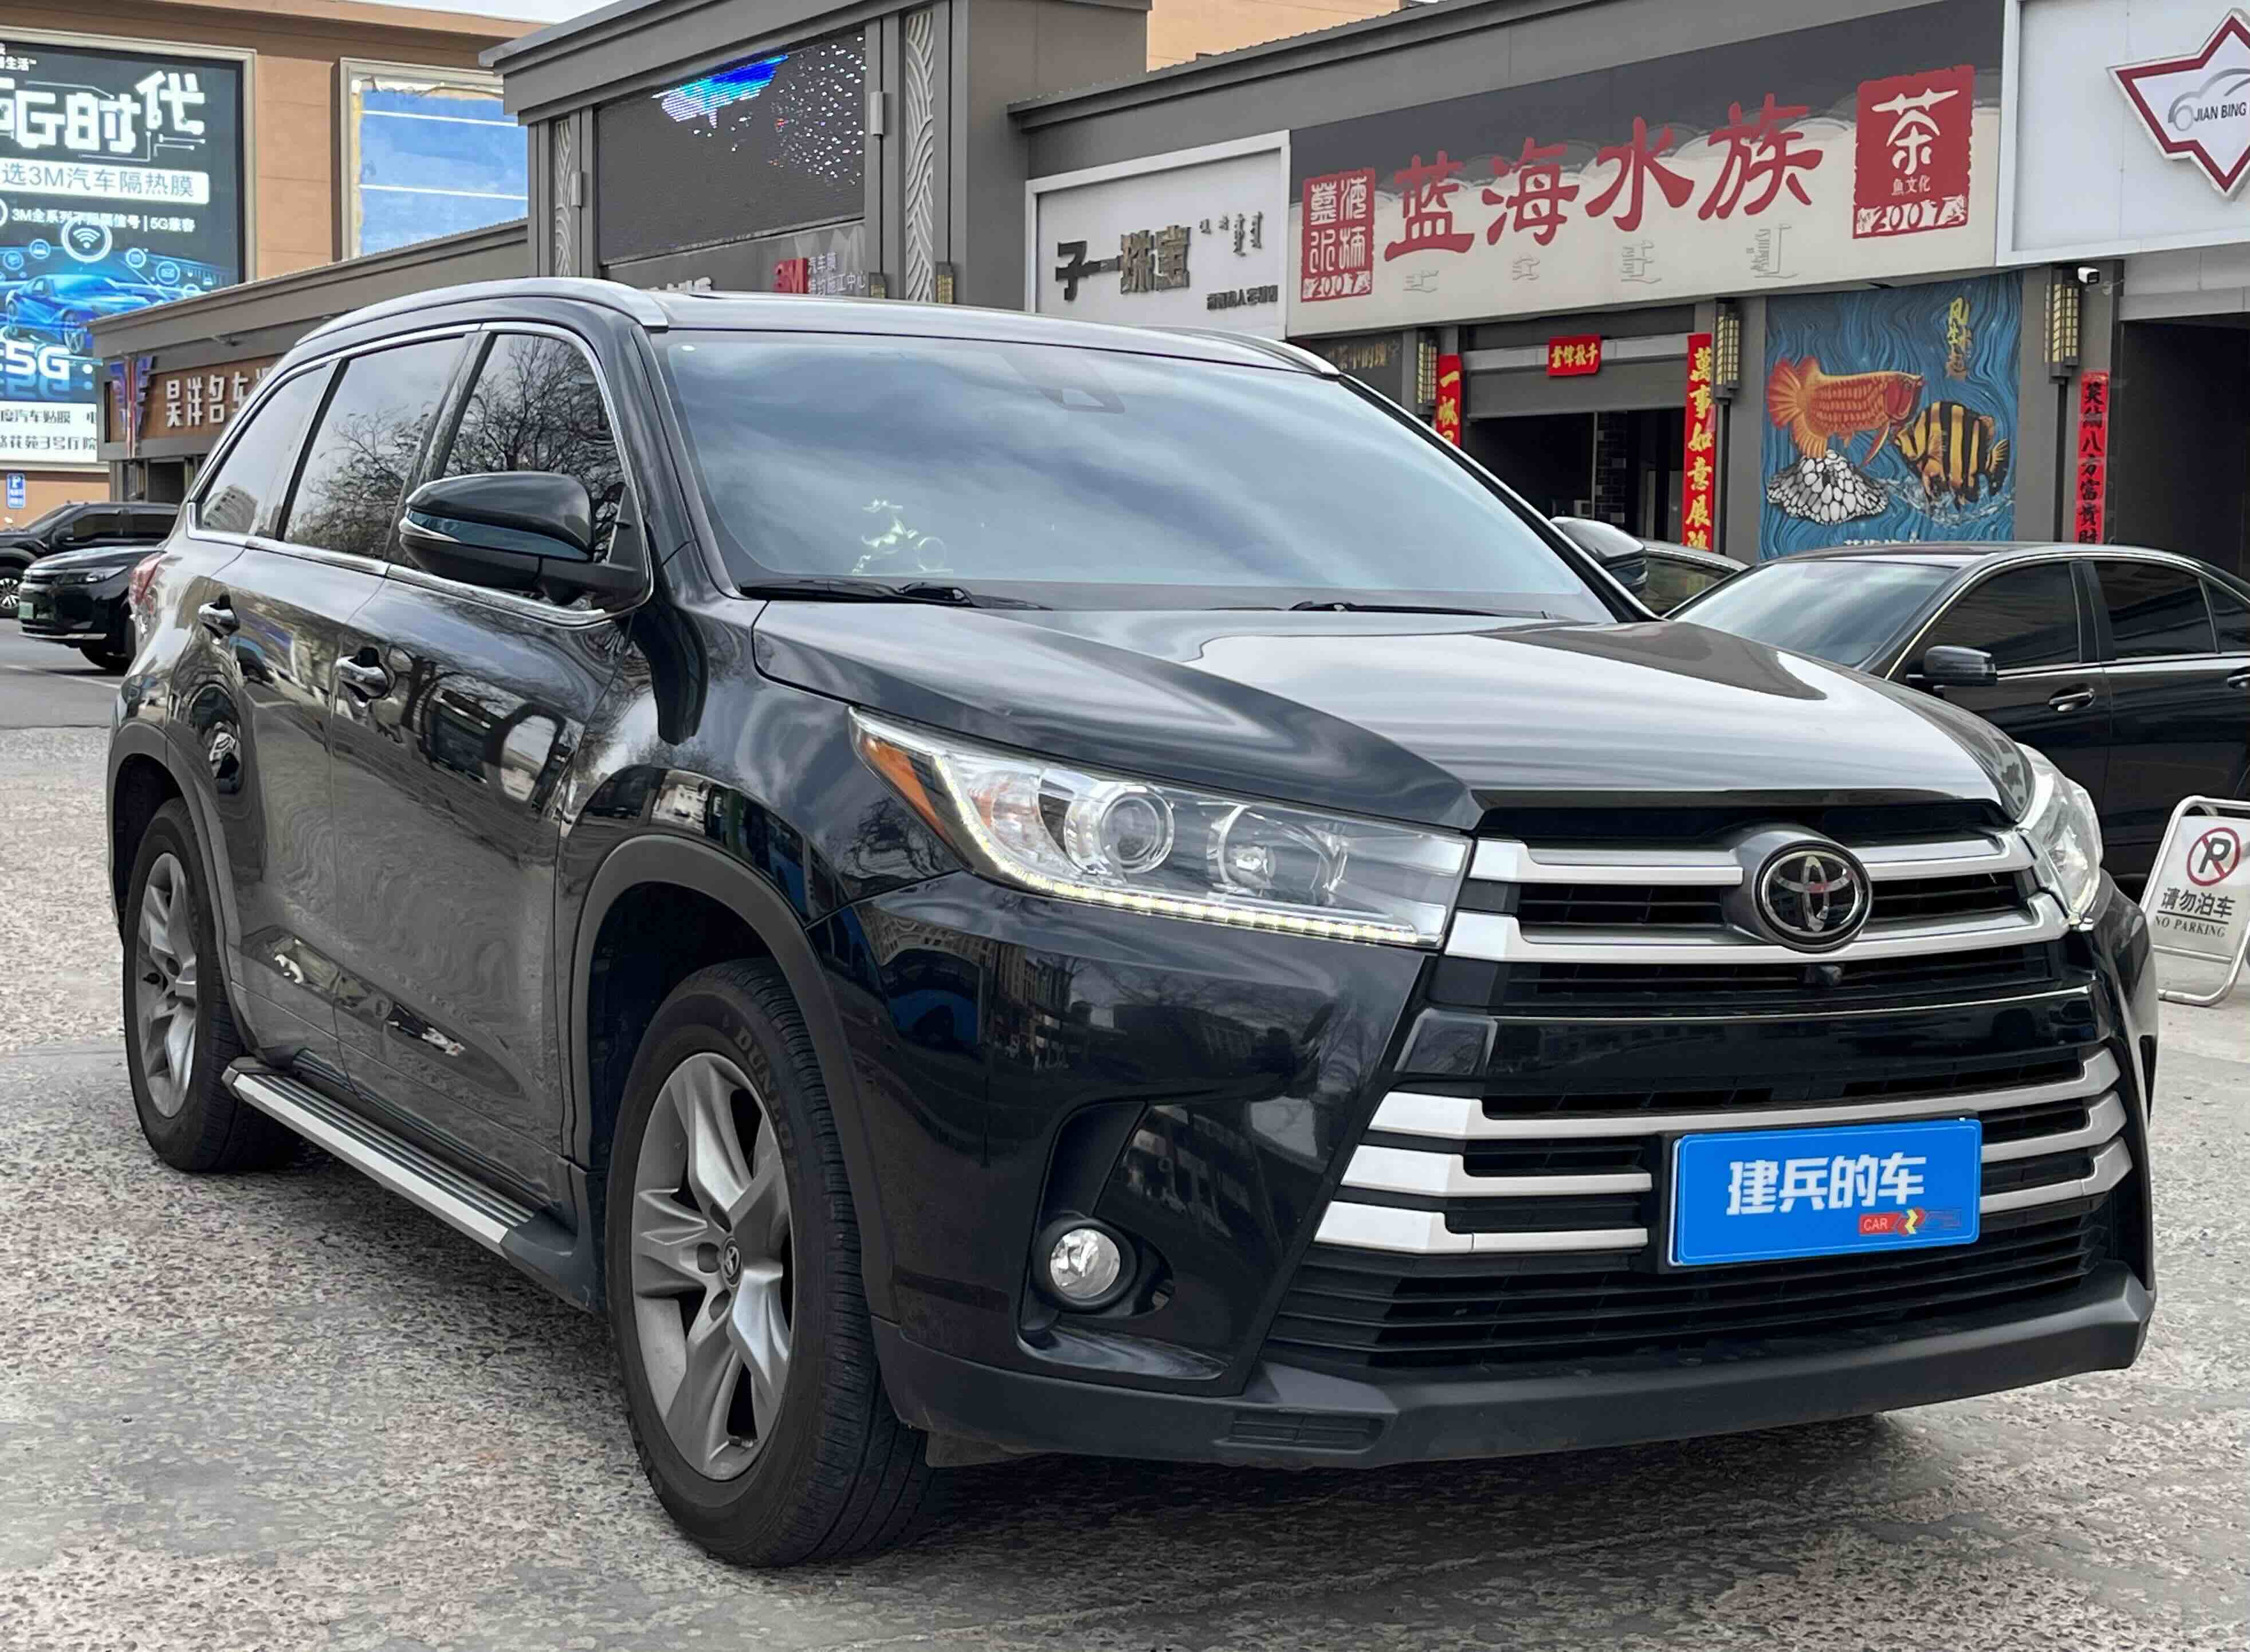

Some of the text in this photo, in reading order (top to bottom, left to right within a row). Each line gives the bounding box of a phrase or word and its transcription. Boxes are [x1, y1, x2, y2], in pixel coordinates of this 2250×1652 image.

[2193, 101, 2247, 122] JIAN BING
[1871, 88, 1959, 175] 茶
[1384, 92, 1823, 262] 蓝海水族
[772, 257, 807, 293] 3M
[2161, 887, 2236, 918] 请勿泊车
[2155, 915, 2227, 938] NO PARKING
[1726, 1151, 1927, 1216] 建兵的车
[1863, 1217, 1888, 1232] CAR
